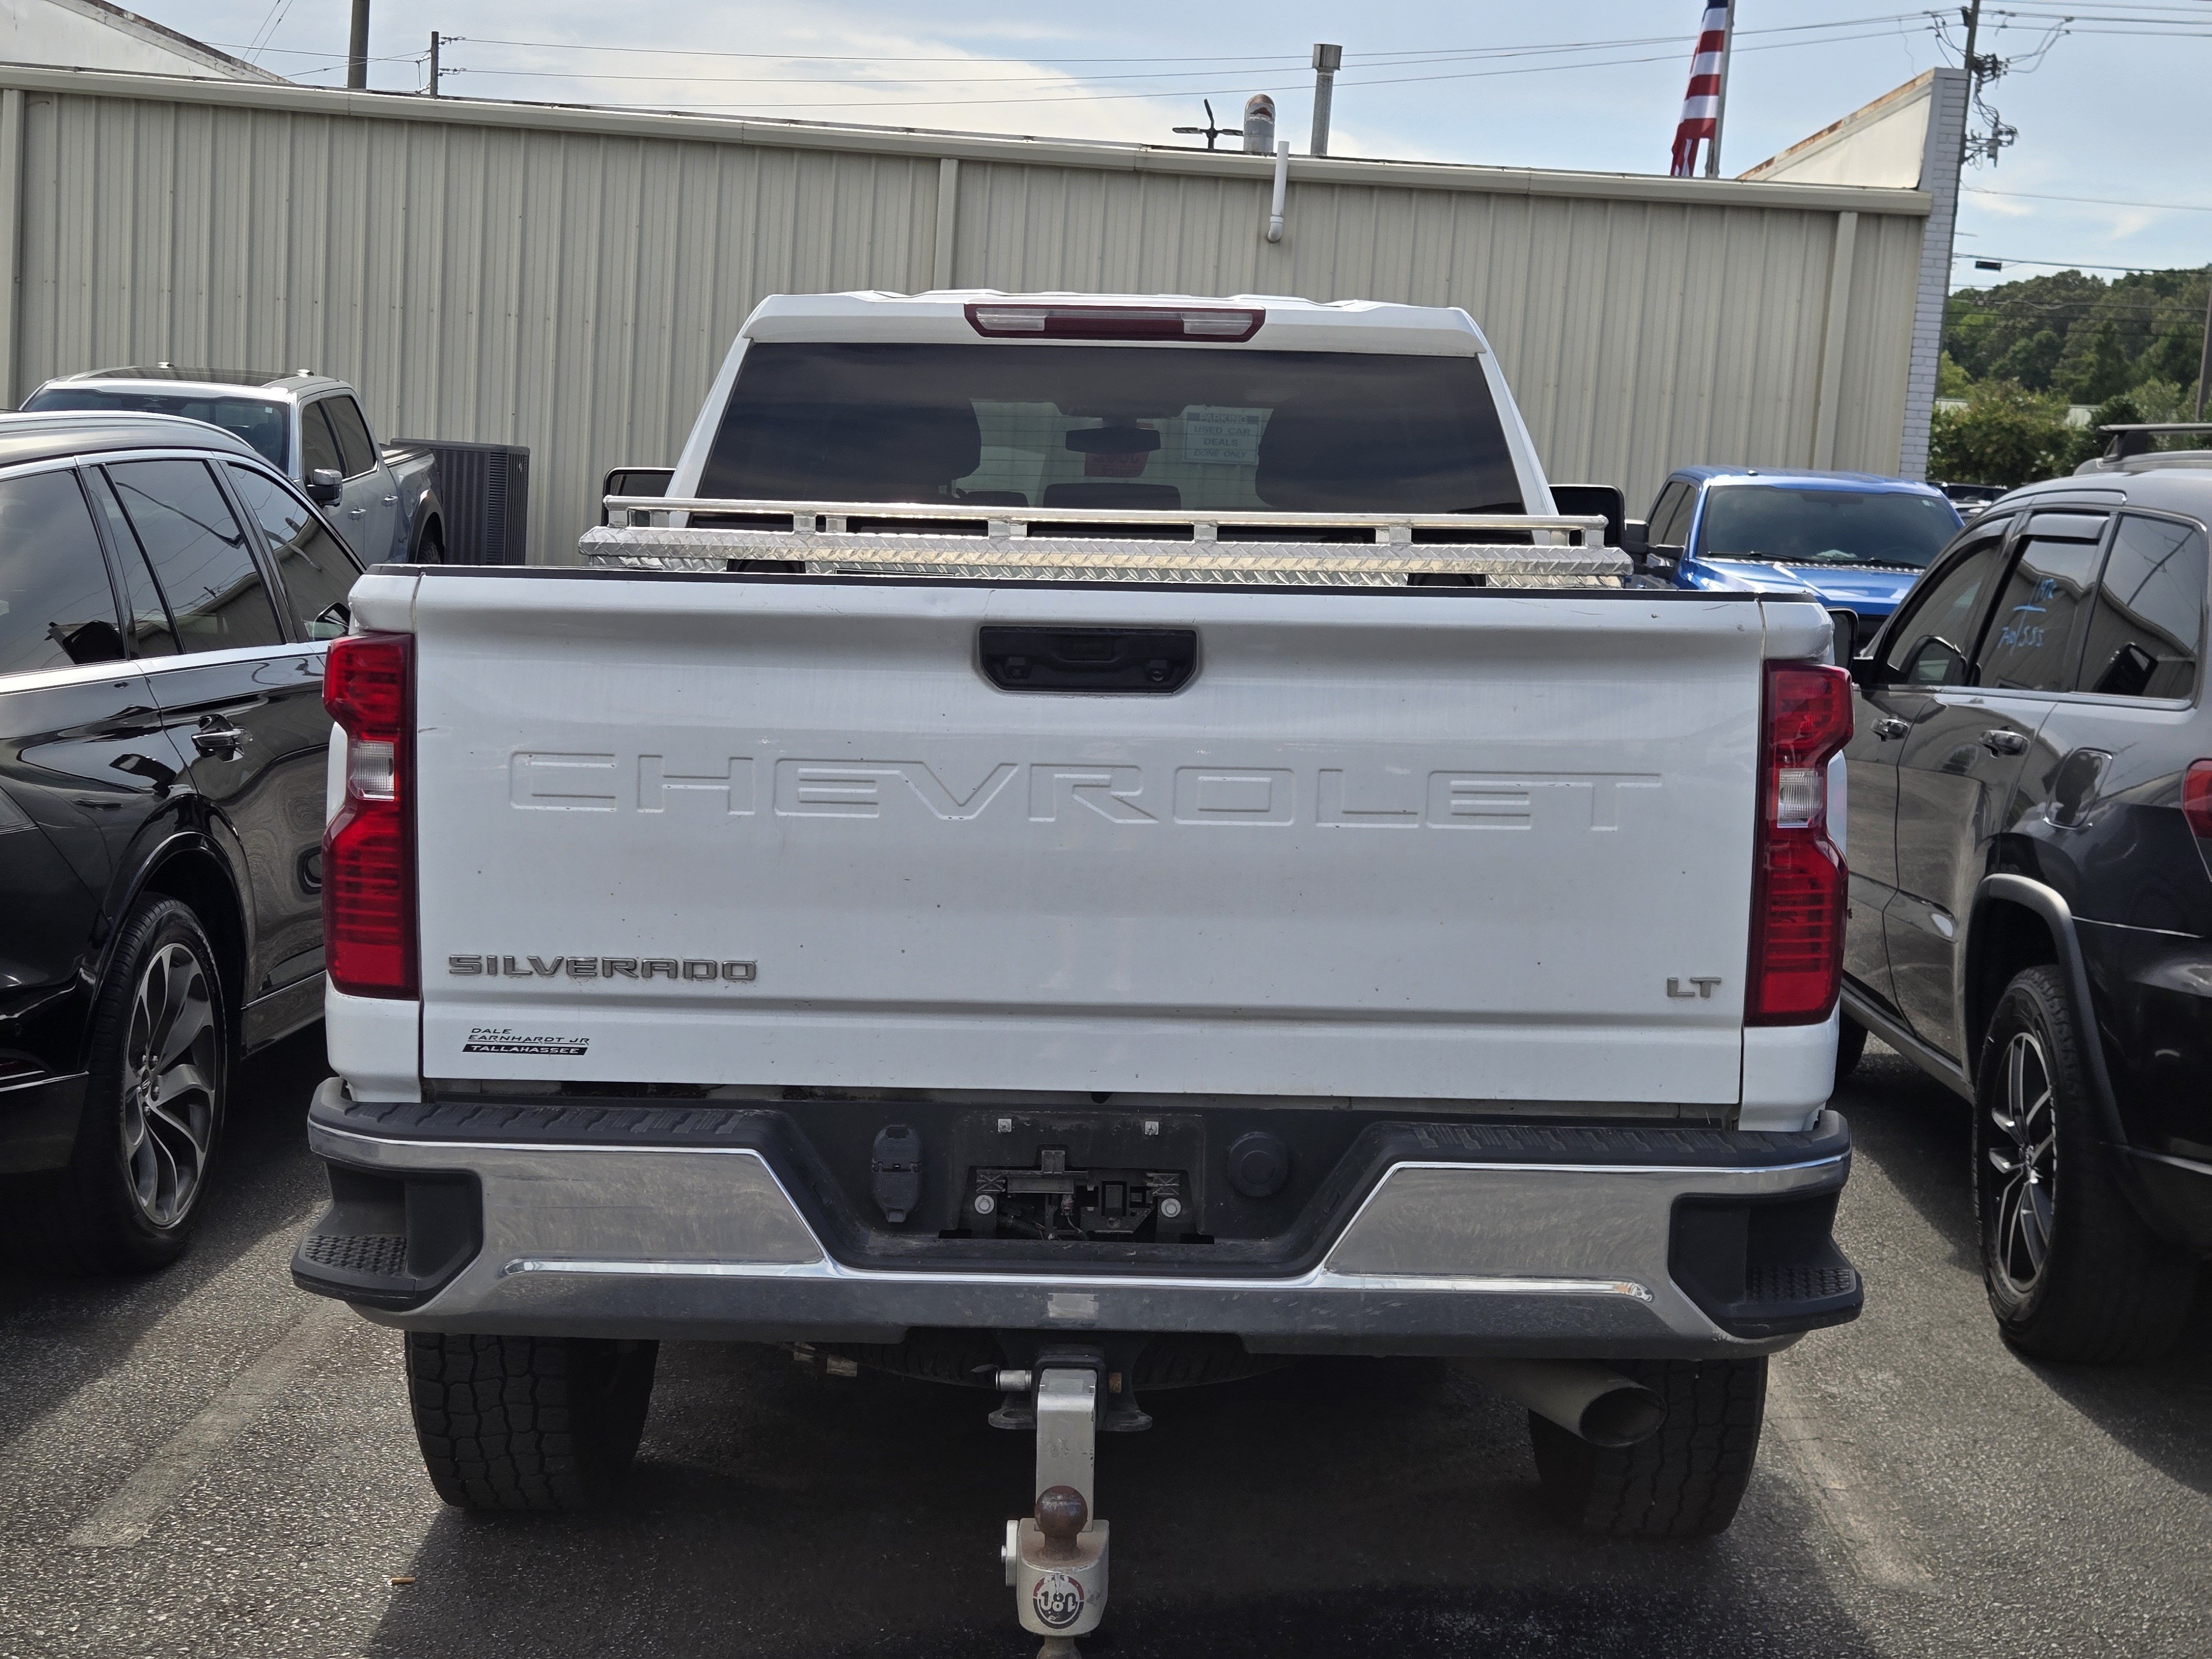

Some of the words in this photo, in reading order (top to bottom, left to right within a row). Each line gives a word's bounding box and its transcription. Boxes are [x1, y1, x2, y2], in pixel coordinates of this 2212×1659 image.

[1201, 413, 1246, 422] PARKING
[1194, 426, 1223, 434] USED
[1228, 427, 1251, 436] CAR
[1203, 437, 1238, 447] DEALS
[509, 751, 1662, 832] CHEVROLET
[448, 954, 757, 981] SILVERADO
[1667, 977, 1721, 998] LT
[468, 1035, 565, 1044] EARNHARDT
[471, 1045, 580, 1055] TALLAHASSEE
